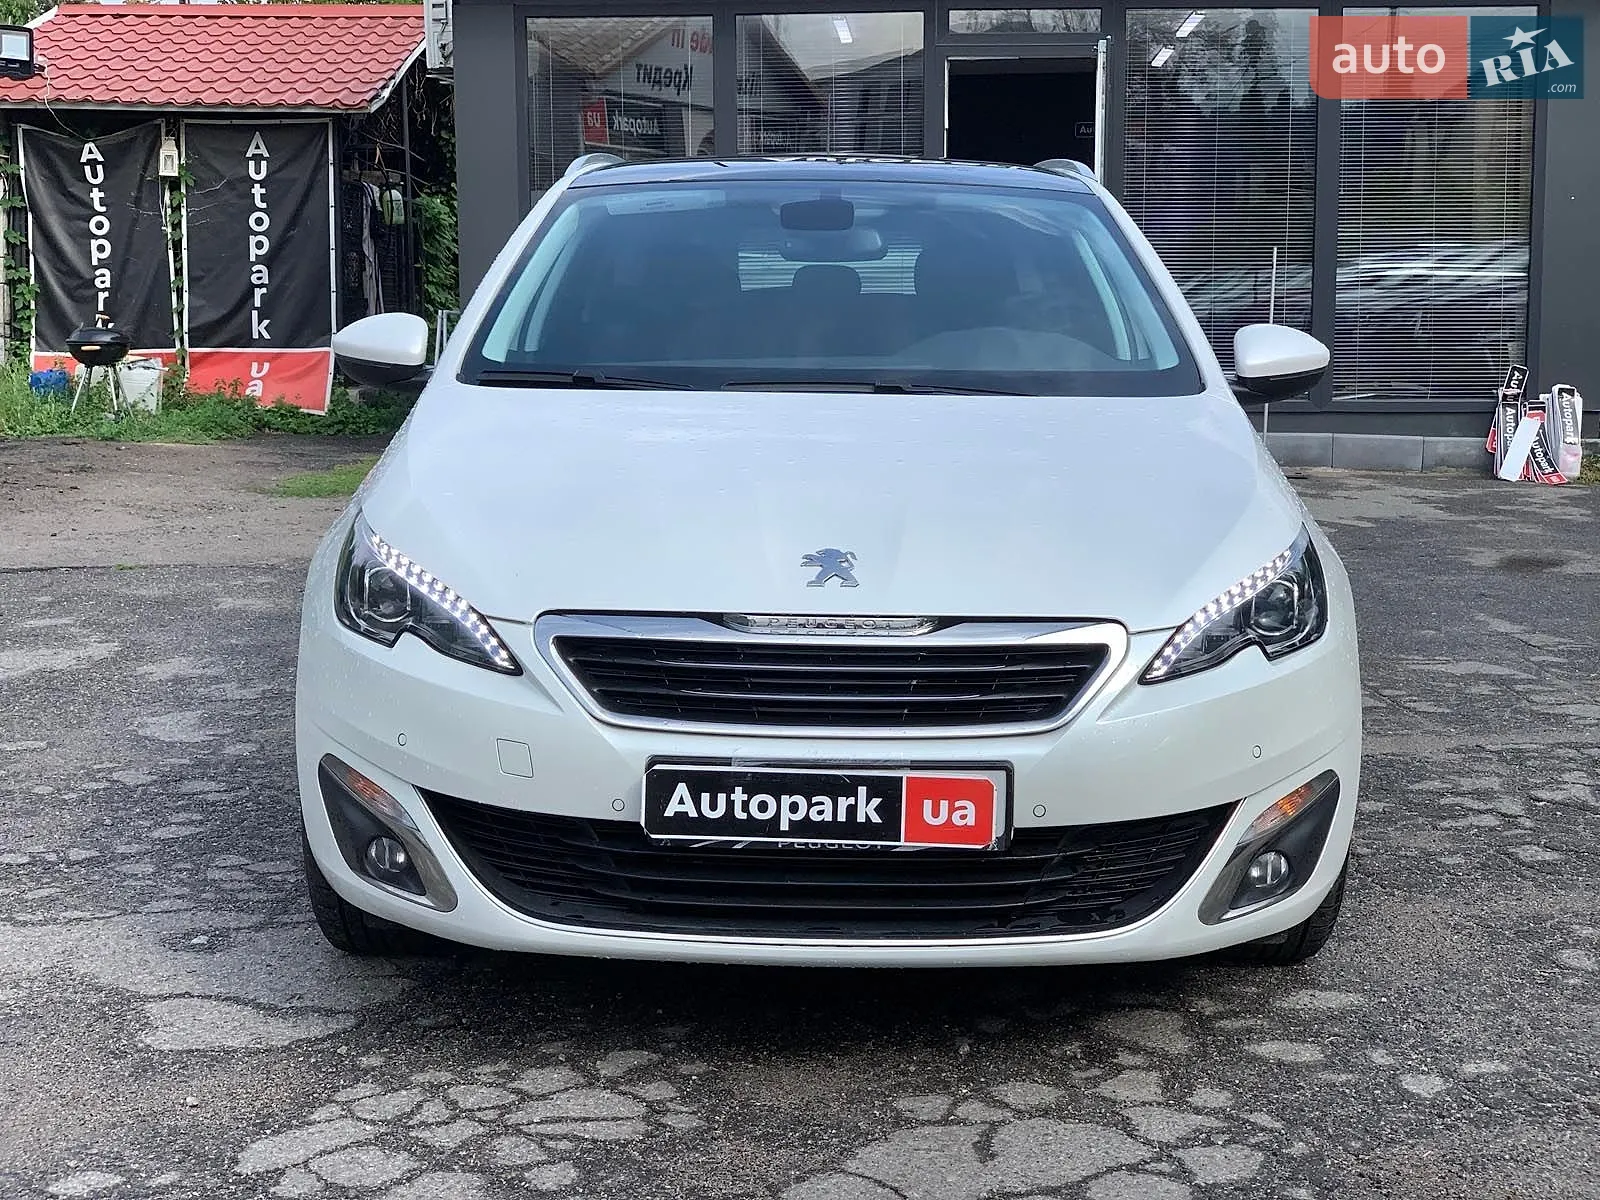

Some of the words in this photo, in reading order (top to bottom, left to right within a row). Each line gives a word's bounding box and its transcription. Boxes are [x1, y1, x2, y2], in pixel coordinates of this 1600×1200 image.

[245, 131, 271, 340] Autopark
[245, 361, 270, 397] ua
[1561, 392, 1579, 445] Autopark
[767, 617, 894, 630] PEUGEOT
[663, 782, 883, 831] Autopark
[922, 797, 976, 827] ua
